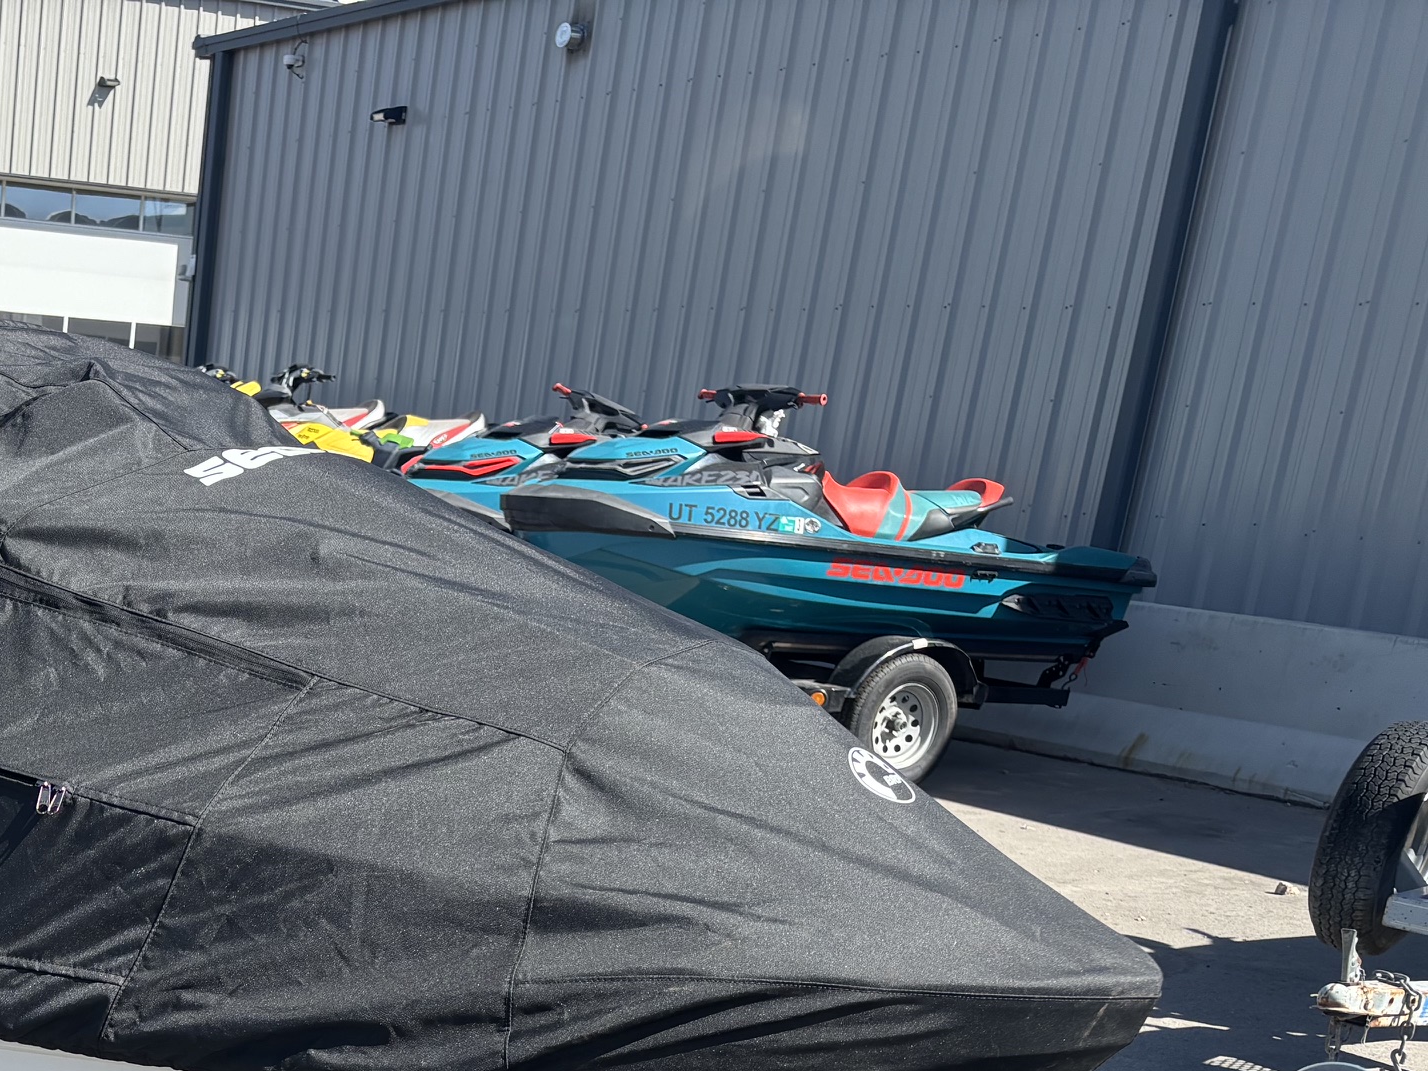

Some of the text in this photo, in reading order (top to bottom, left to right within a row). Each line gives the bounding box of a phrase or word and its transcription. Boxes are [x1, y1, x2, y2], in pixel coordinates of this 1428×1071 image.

[668, 502, 698, 523] UT
[703, 506, 750, 529] 5288
[754, 511, 781, 532] YZ
